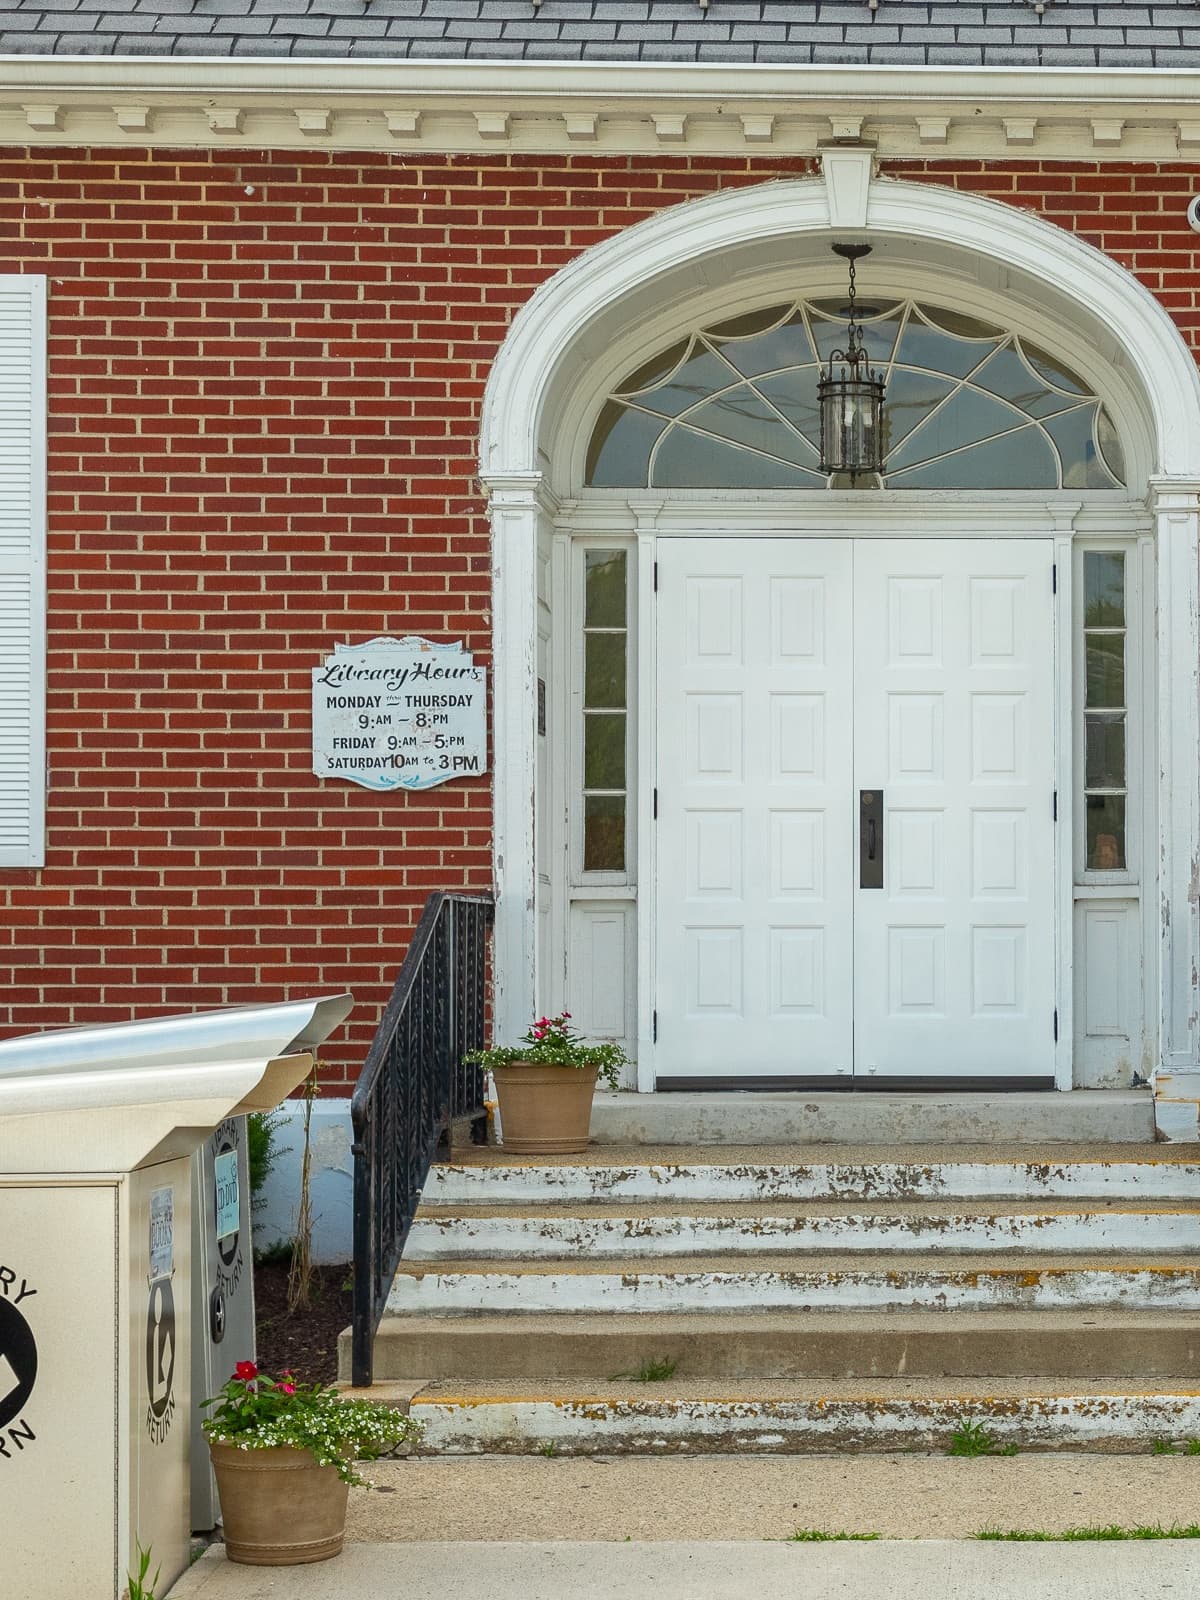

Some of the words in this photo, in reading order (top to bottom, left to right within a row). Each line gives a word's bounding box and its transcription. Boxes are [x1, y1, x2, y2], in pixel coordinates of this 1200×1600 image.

[317, 664, 409, 691] Library
[409, 662, 480, 681] Hours
[326, 696, 382, 709] MONDAY
[404, 695, 473, 707] THURSDAY
[333, 737, 376, 749] FRIDAY
[327, 757, 387, 769] SATURDAY
[423, 757, 434, 765] to
[146, 1390, 175, 1446] RETURN
